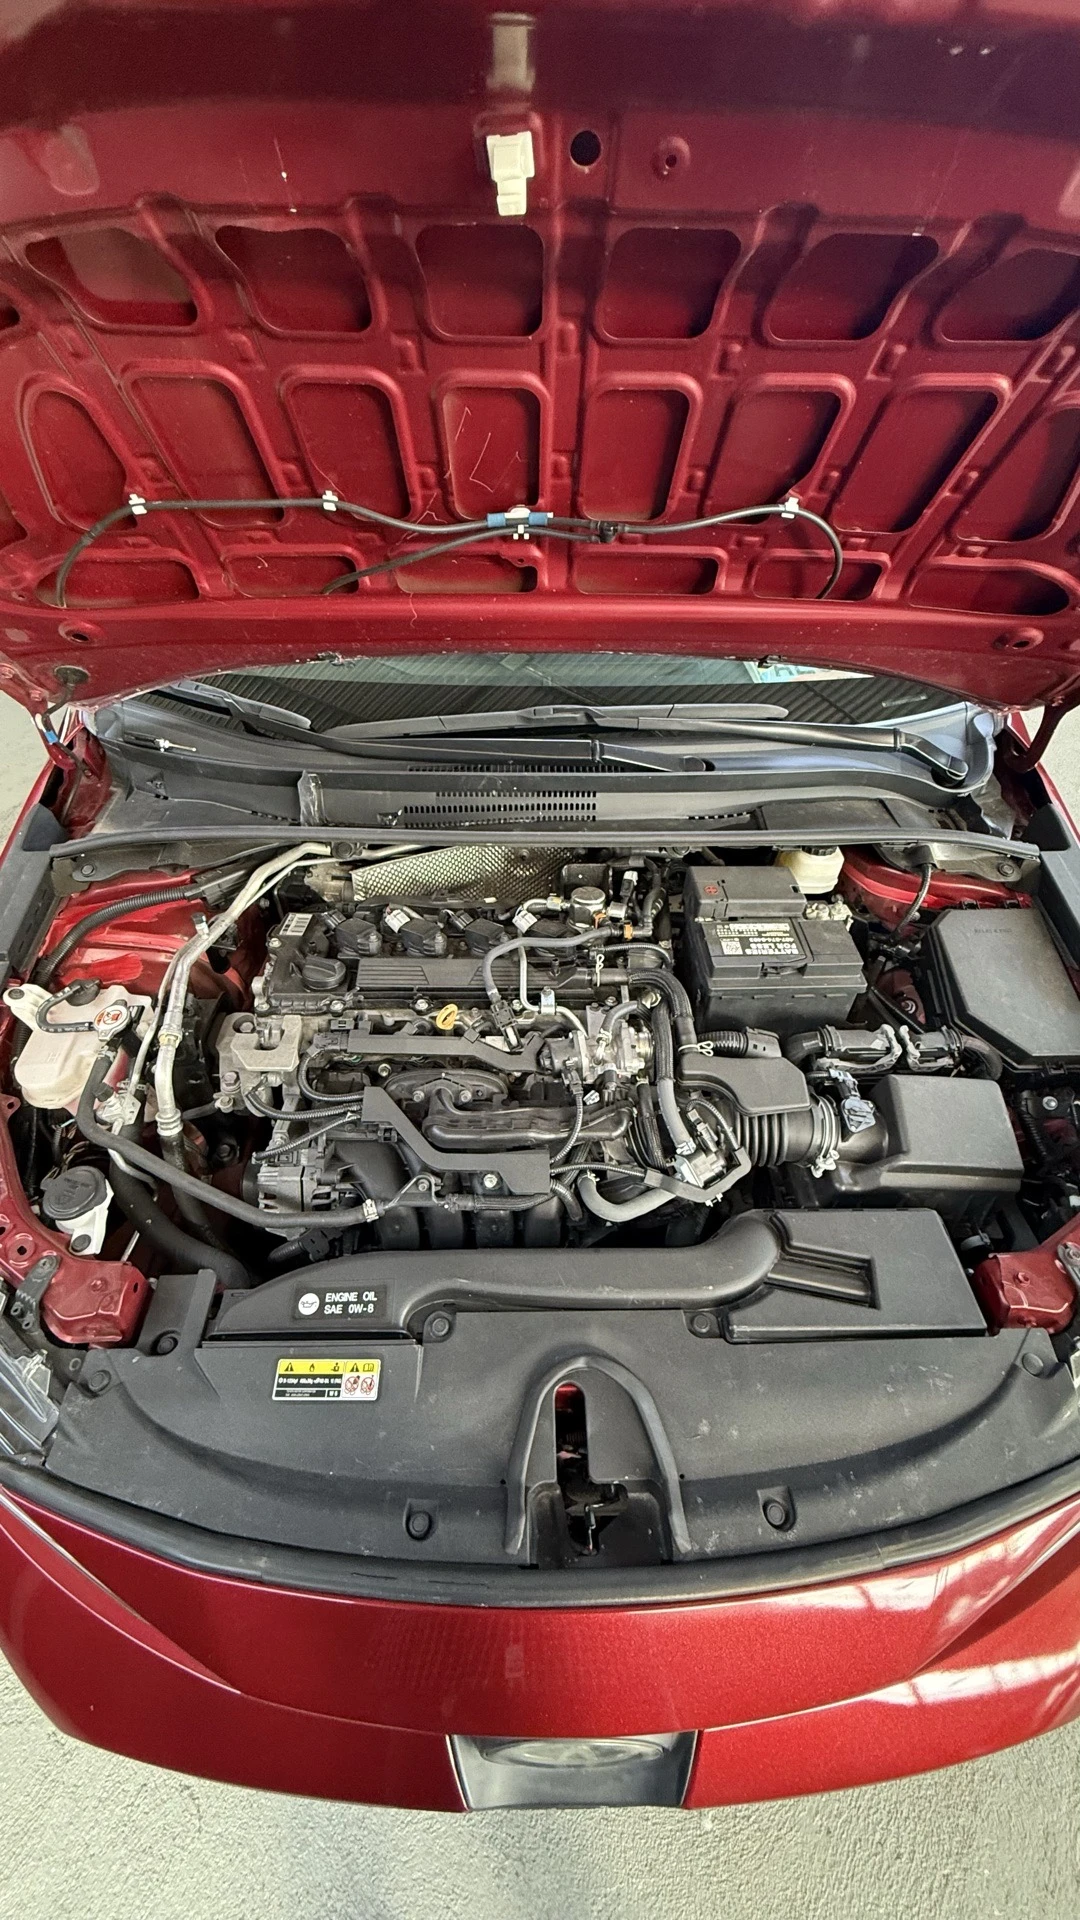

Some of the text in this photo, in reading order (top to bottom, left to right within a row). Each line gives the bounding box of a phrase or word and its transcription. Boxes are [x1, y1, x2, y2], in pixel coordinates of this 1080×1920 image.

[325, 1291, 378, 1302] ENGINE OIL
[324, 1303, 374, 1314] SAE 0W-8
